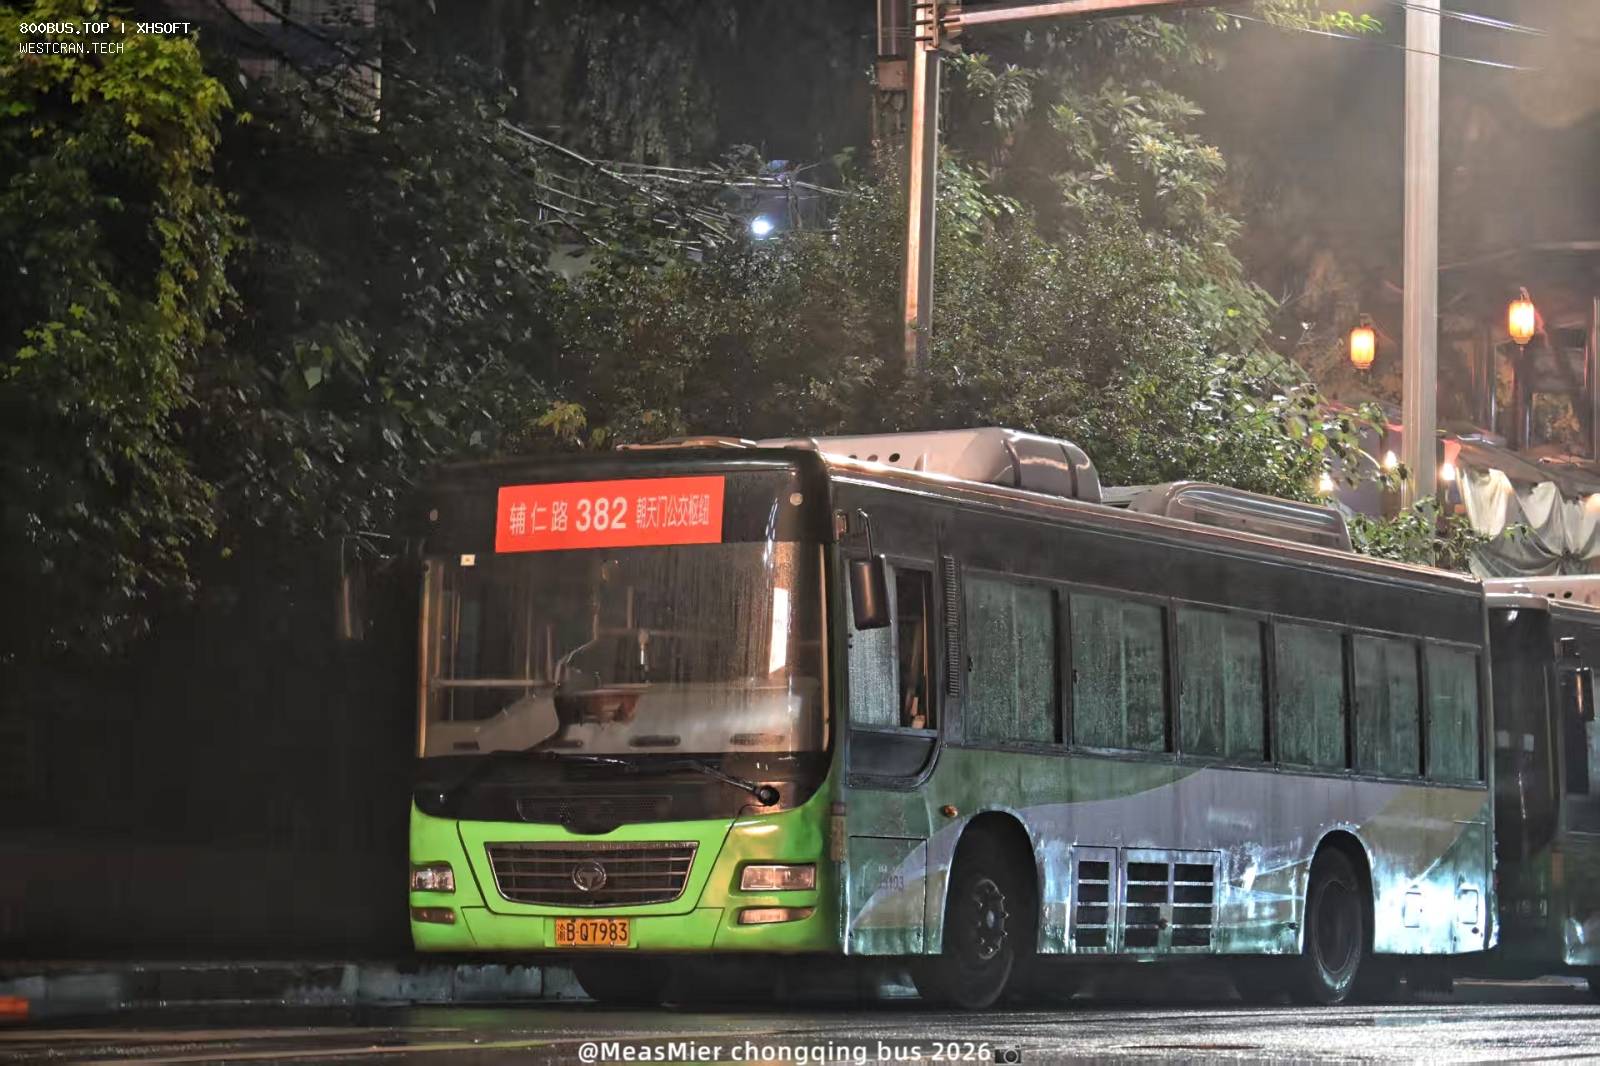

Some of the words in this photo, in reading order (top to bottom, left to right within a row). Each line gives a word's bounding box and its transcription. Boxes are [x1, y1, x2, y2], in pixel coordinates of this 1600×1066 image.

[509, 501, 568, 535] 辅仁路
[575, 496, 628, 532] 382
[635, 495, 711, 528] 朝天门公交枢纽
